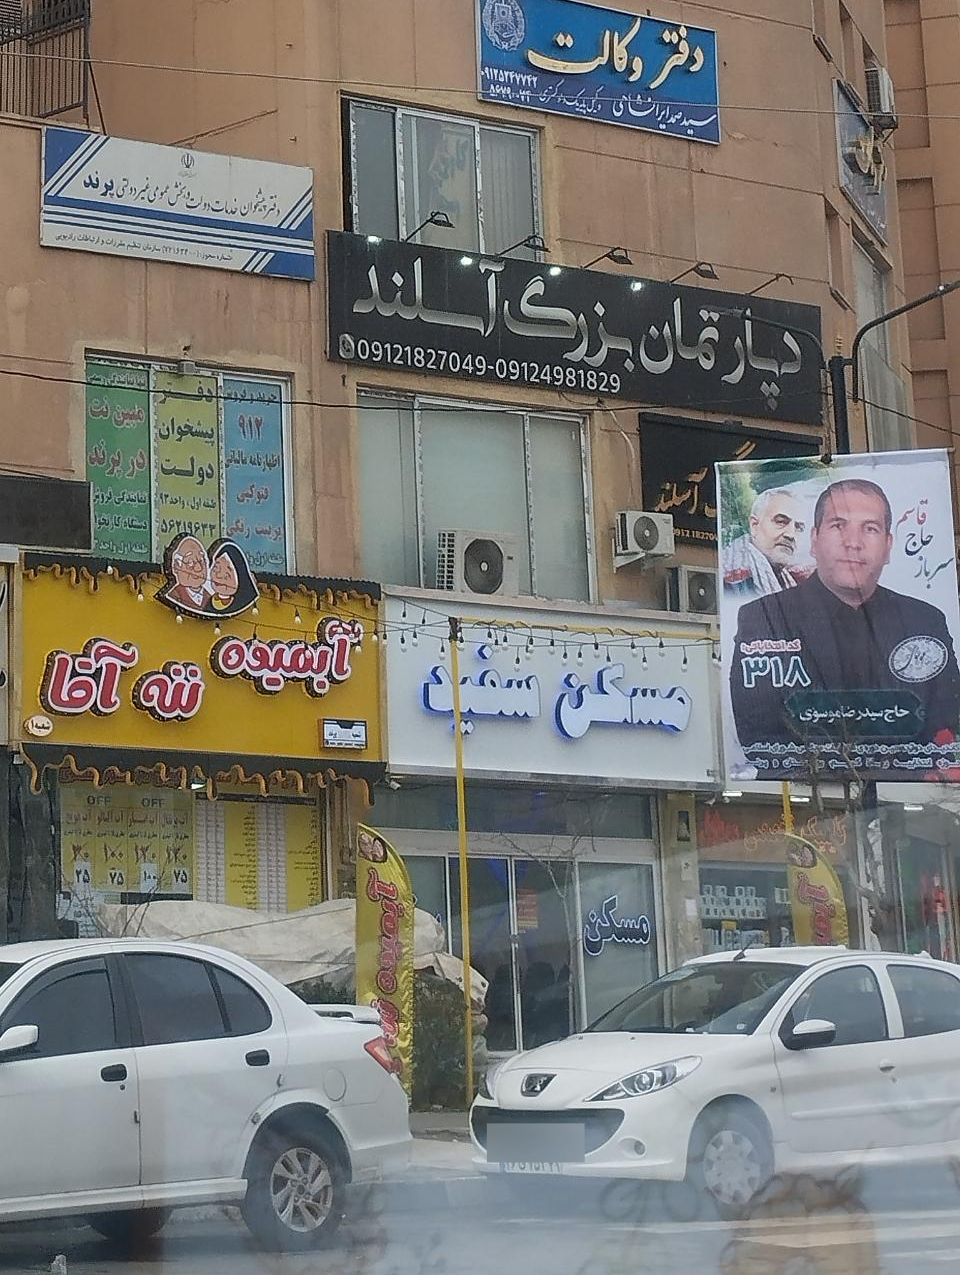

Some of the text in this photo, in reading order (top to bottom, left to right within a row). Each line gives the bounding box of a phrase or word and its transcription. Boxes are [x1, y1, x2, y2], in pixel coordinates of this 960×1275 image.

[526, 17, 704, 90] دفتر وکالت
[680, 112, 717, 135] سید
[82, 170, 114, 198] پرند
[186, 196, 210, 212] دولت
[210, 197, 238, 216] خدمات
[239, 187, 268, 217] پیشخوان
[262, 194, 281, 220] دفتر
[503, 274, 636, 373] بزرگ
[639, 296, 802, 412] دپارتمان
[89, 396, 111, 420] نت
[159, 380, 214, 405] دفتر
[158, 416, 215, 447] پیشخوان
[89, 439, 148, 477] در پرند
[160, 455, 215, 486] دولت
[894, 499, 929, 533] قاسم
[904, 526, 934, 557] حاج
[914, 555, 954, 590] سرباز
[216, 618, 364, 696] آبمیوه
[741, 656, 812, 688] ۳۱۸
[43, 638, 139, 715] آقا
[555, 662, 693, 739] مسکن
[799, 706, 843, 723] موسوی
[883, 704, 910, 723] حاج
[86, 795, 113, 805] OFF
[141, 797, 166, 808] OFF
[584, 894, 651, 956] مسکن
